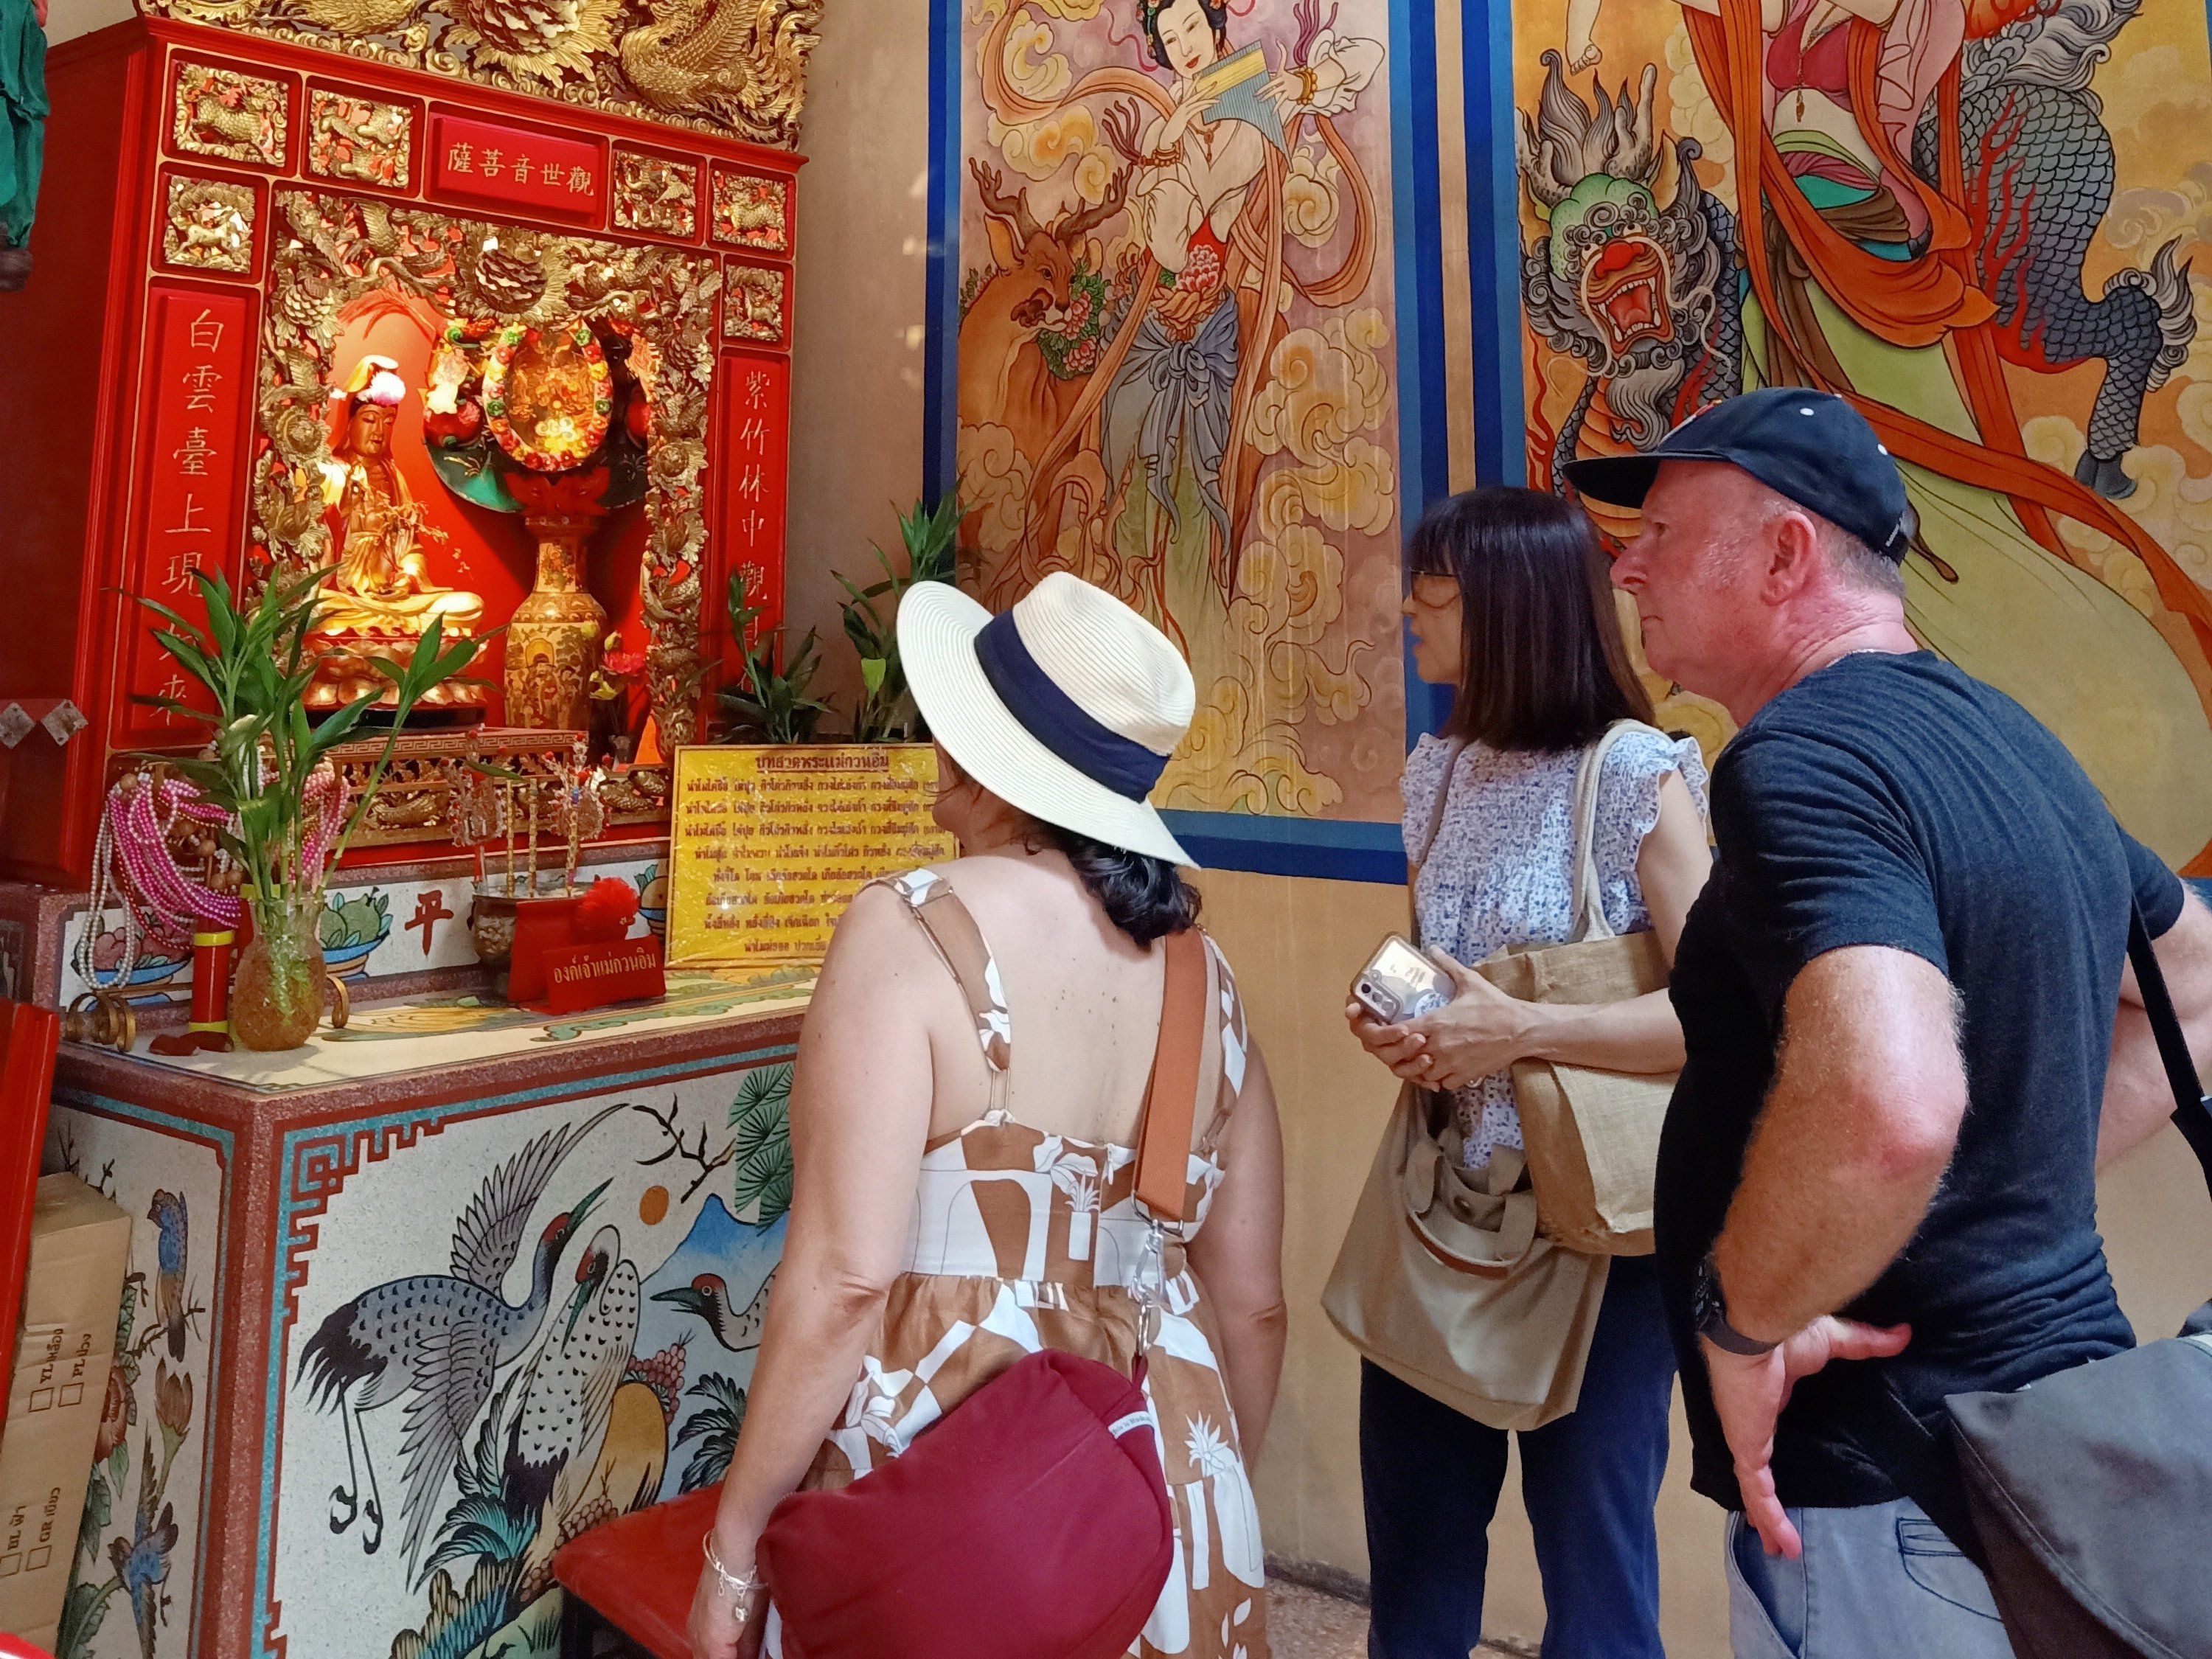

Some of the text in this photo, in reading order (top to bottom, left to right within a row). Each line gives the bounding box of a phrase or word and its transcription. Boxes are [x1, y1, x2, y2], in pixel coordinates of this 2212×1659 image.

[405, 889, 454, 956] 平
[554, 947, 656, 984] องค์เจ้าแม่กวนอิม
[40, 1363, 54, 1384] YL
[72, 1358, 86, 1377] PL
[7, 1529, 21, 1551] BL
[39, 1520, 53, 1543] GR
